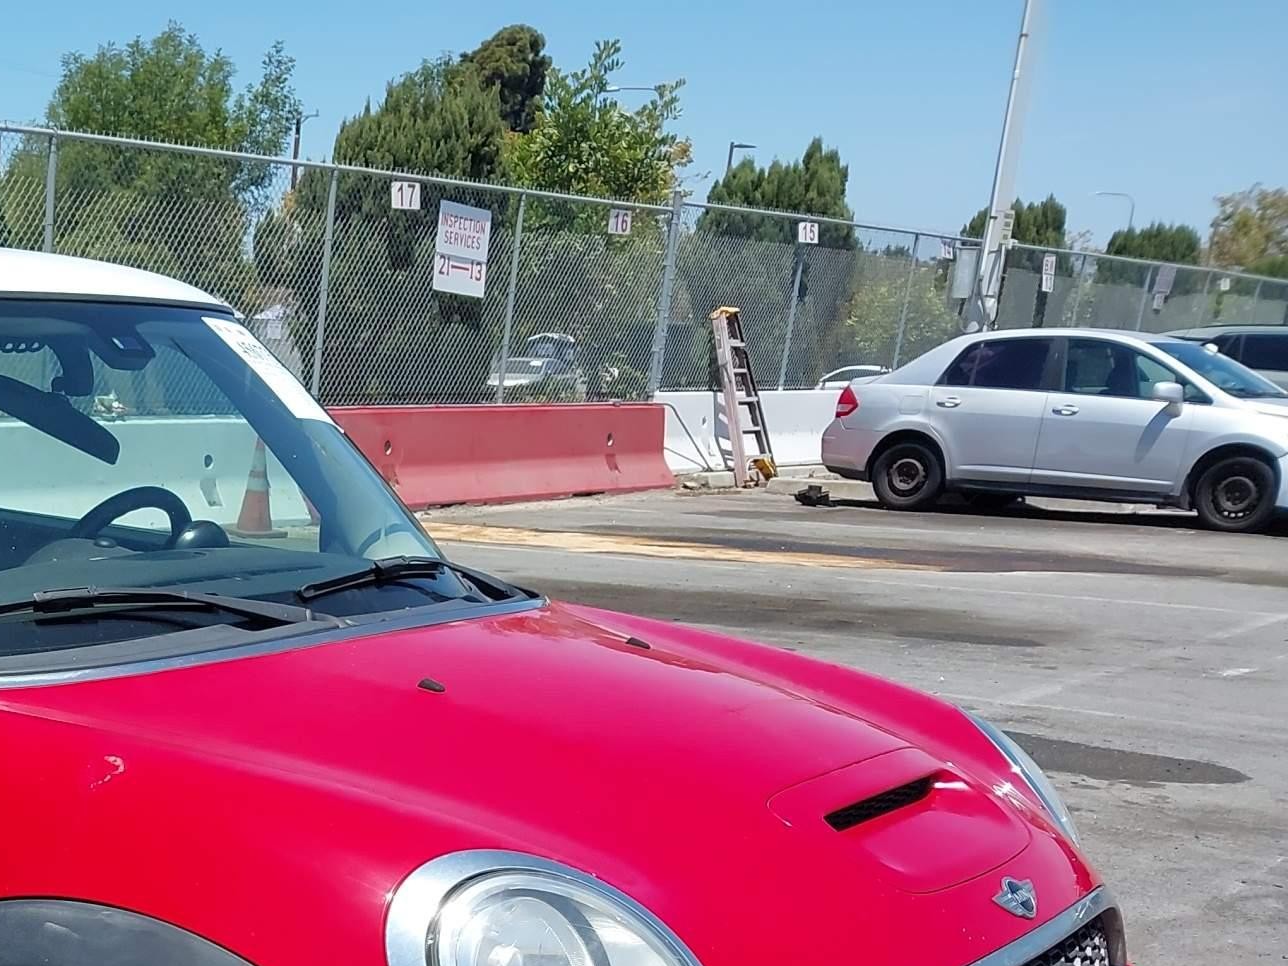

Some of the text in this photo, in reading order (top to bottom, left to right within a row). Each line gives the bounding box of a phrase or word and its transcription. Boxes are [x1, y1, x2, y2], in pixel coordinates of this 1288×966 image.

[397, 183, 416, 208] 17
[441, 212, 487, 236] INSPECTION
[613, 210, 629, 233] 16
[802, 223, 816, 242] 15
[444, 229, 481, 251] SERVICES
